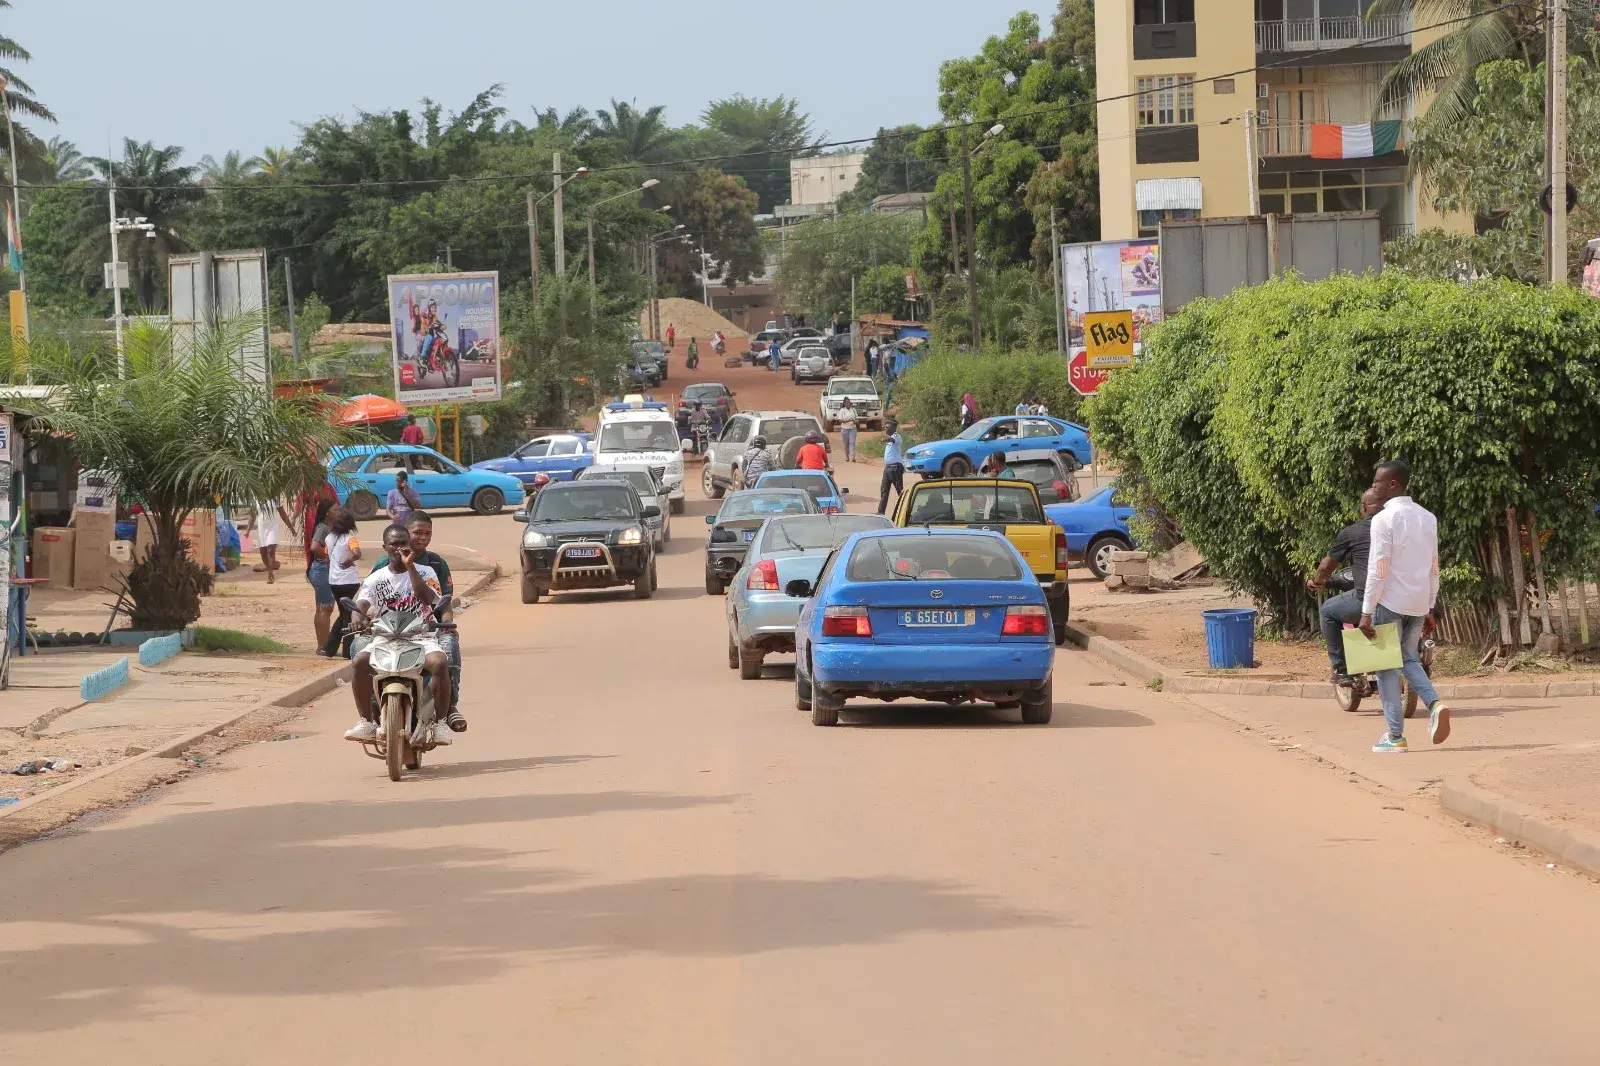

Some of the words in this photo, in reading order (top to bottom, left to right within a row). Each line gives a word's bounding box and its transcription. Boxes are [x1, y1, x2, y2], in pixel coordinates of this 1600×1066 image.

[397, 283, 493, 308] APSONIC
[1090, 321, 1130, 346] Flag
[917, 610, 958, 623] 65ET01
